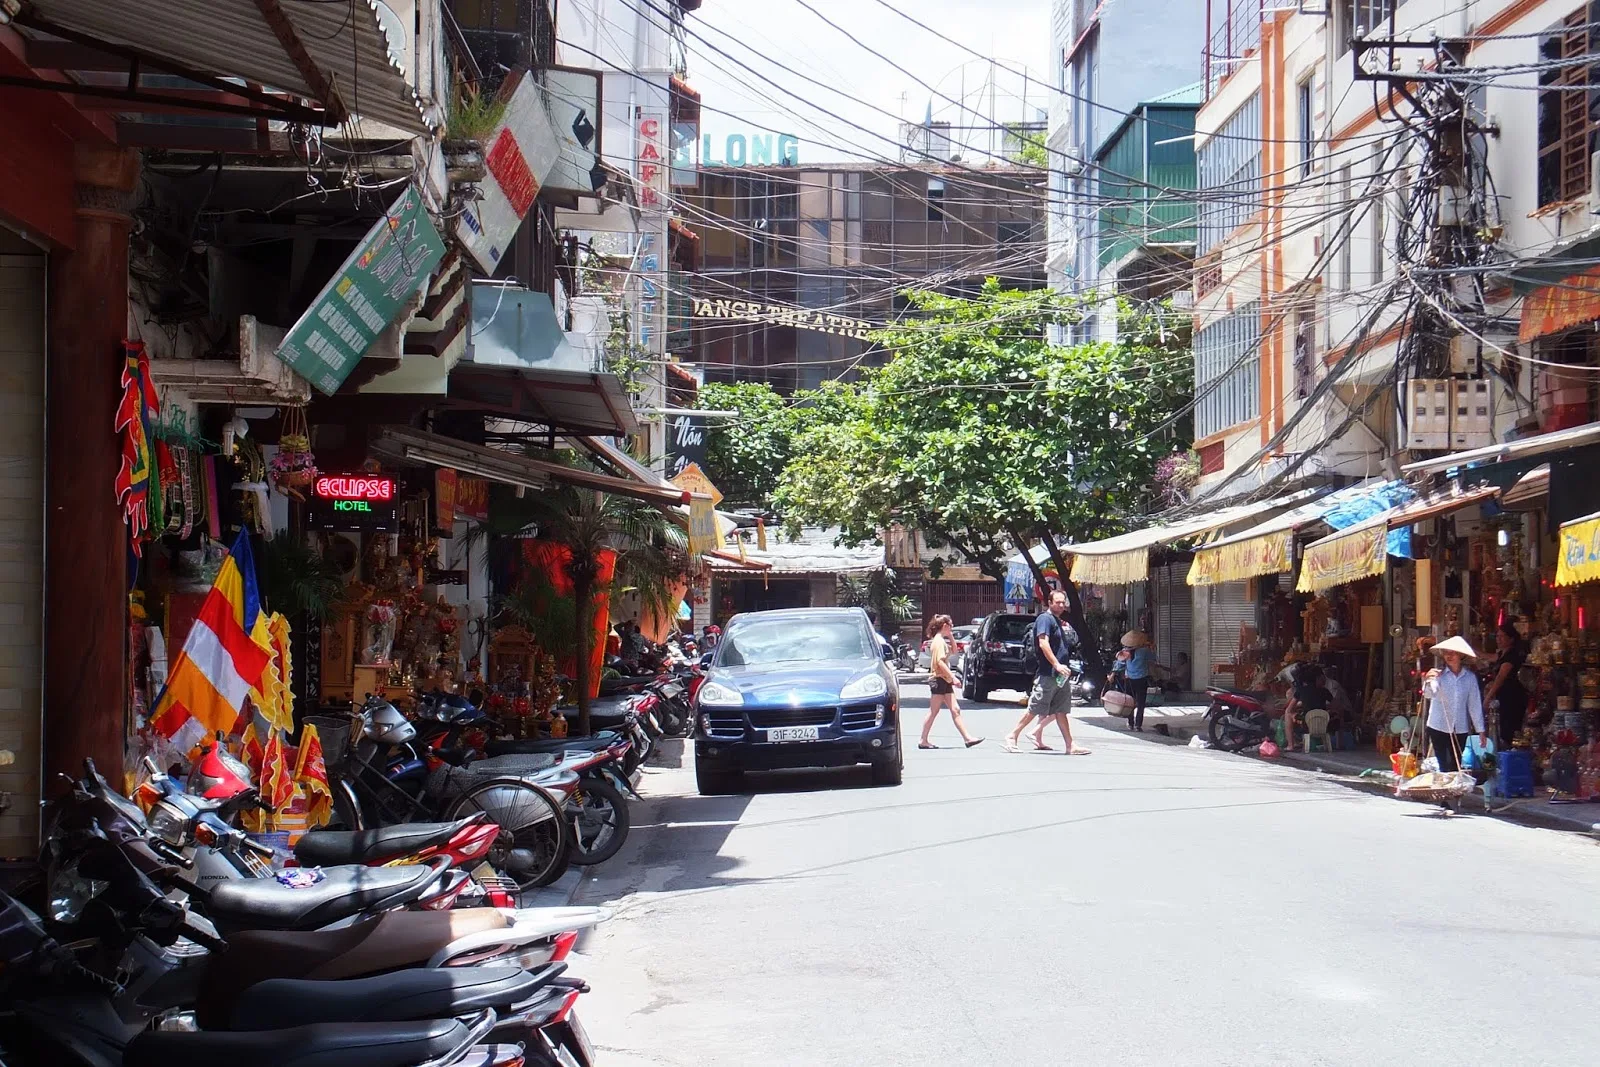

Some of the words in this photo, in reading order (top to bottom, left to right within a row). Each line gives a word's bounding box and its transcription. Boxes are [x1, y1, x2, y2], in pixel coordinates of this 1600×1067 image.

[703, 133, 799, 167] LONG
[766, 305, 872, 341] THEATRE
[316, 477, 391, 499] ECLIPSE
[333, 500, 372, 512] HOTEL
[773, 727, 817, 740] 31F-3242
